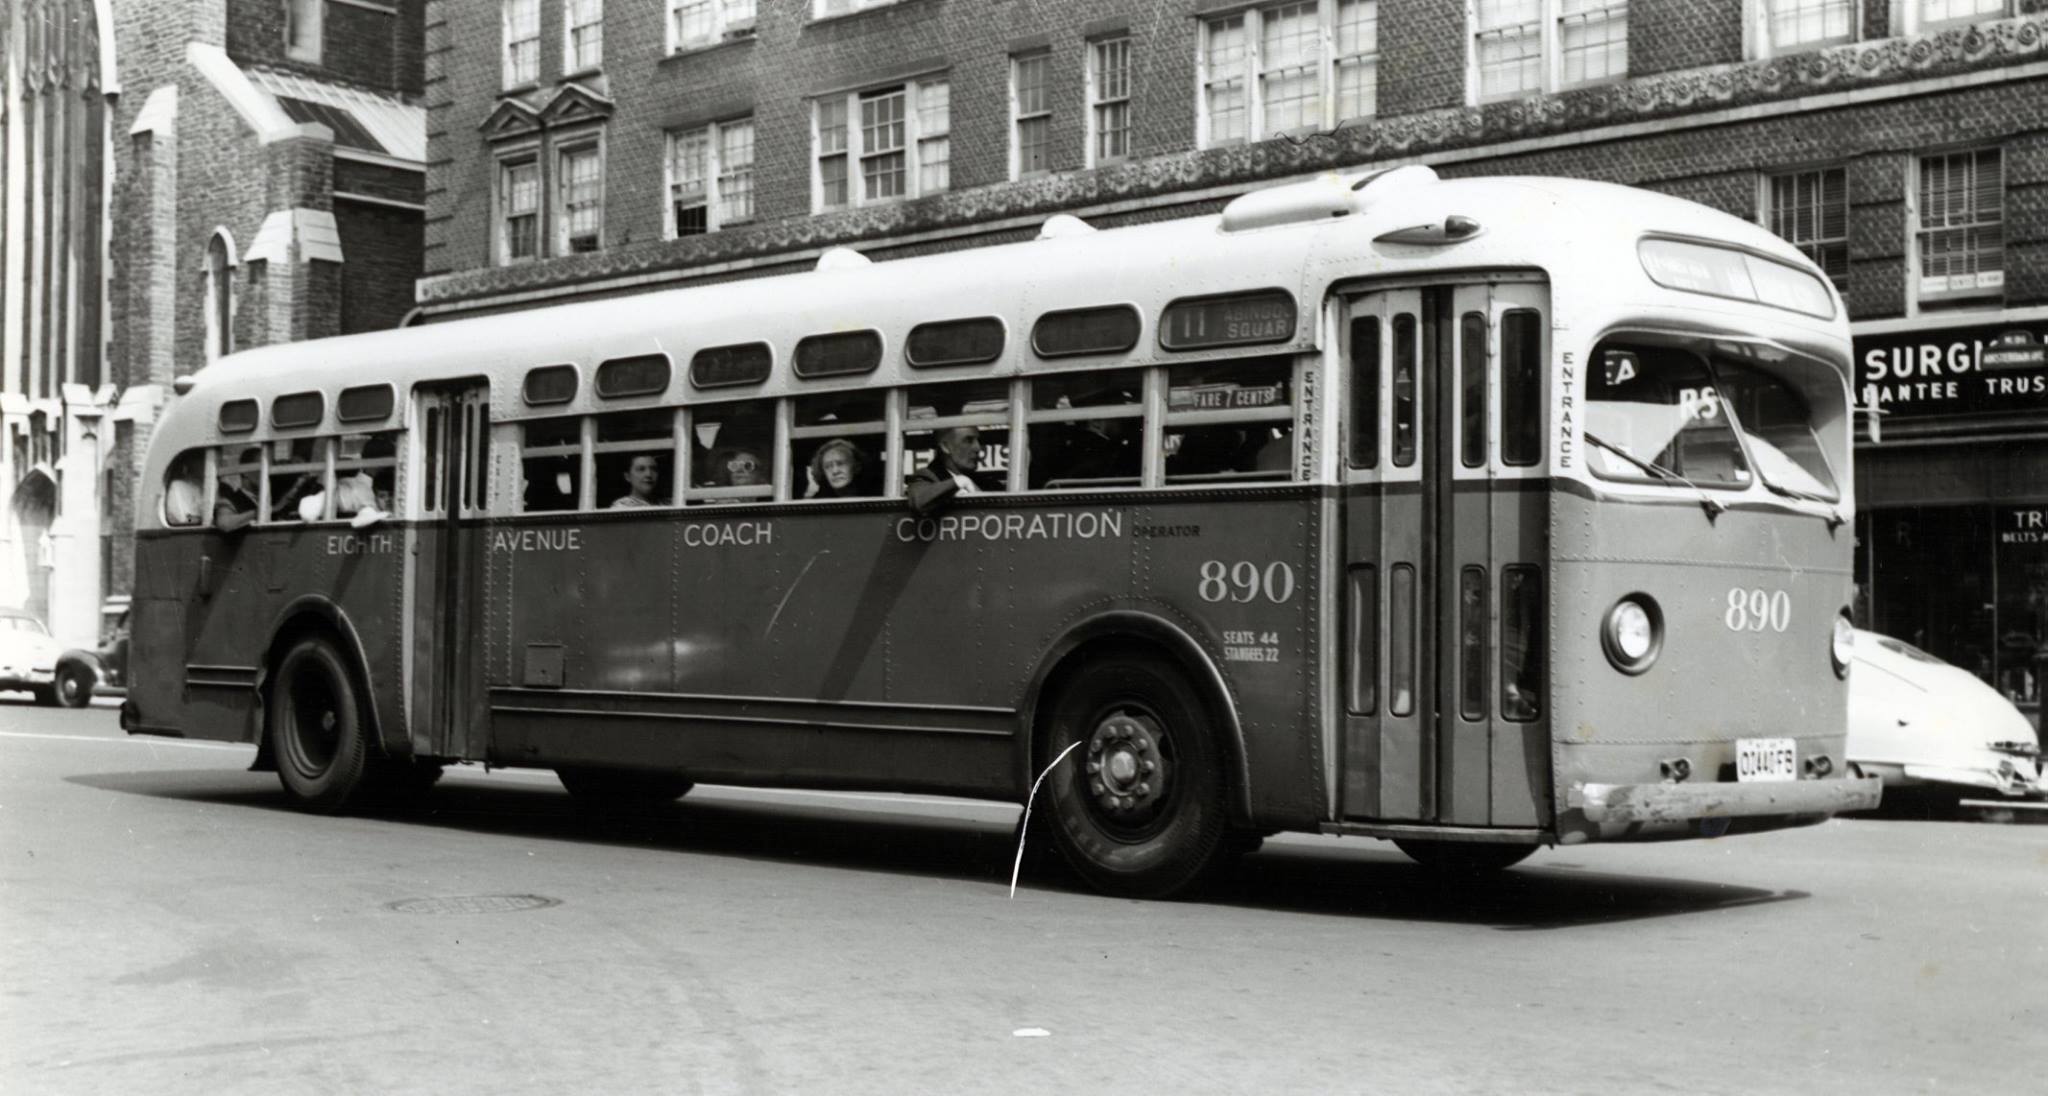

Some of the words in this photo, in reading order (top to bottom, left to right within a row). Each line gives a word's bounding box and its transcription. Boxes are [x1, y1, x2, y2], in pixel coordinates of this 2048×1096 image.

[1227, 318, 1292, 339] SQUAR
[1864, 339, 1998, 381] SURGI
[1301, 370, 1314, 482] ENTRANCE
[1560, 351, 1574, 469] ENTRANCE
[326, 534, 393, 555] EIGHTH
[493, 528, 582, 552] AVENUE
[683, 521, 773, 548] COACH
[896, 511, 1122, 542] CORPORATION
[1131, 524, 1201, 538] OPERATOR
[2013, 510, 2048, 529] TR
[1198, 559, 1295, 604] 890
[1724, 587, 1792, 633] 890
[1222, 630, 1255, 645] SEATS
[1259, 631, 1280, 645] 44
